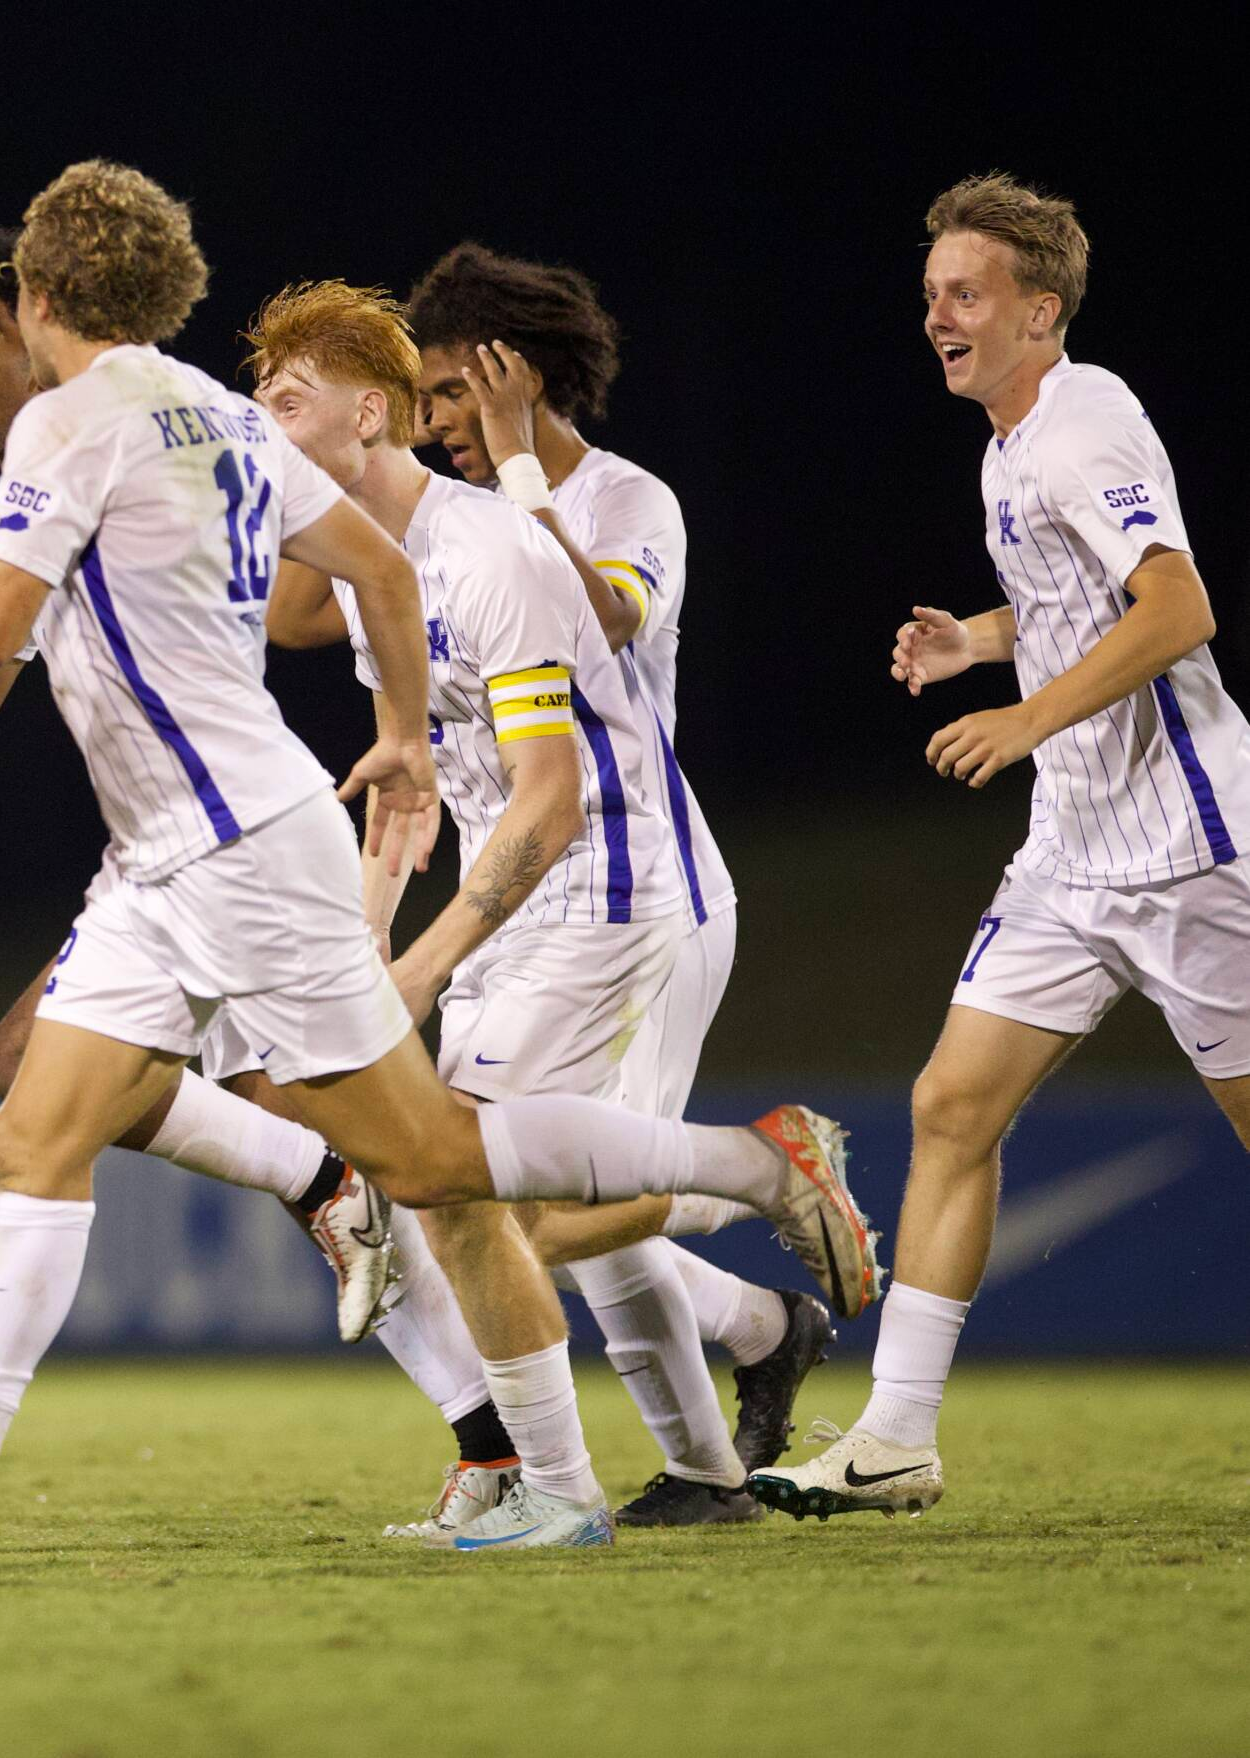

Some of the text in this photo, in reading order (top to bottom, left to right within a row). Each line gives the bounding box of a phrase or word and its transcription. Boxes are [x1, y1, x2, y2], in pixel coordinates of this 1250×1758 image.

[6, 481, 50, 512] SBC
[1103, 483, 1149, 508] SBC
[214, 448, 271, 602] 12
[961, 916, 1005, 982] 7
